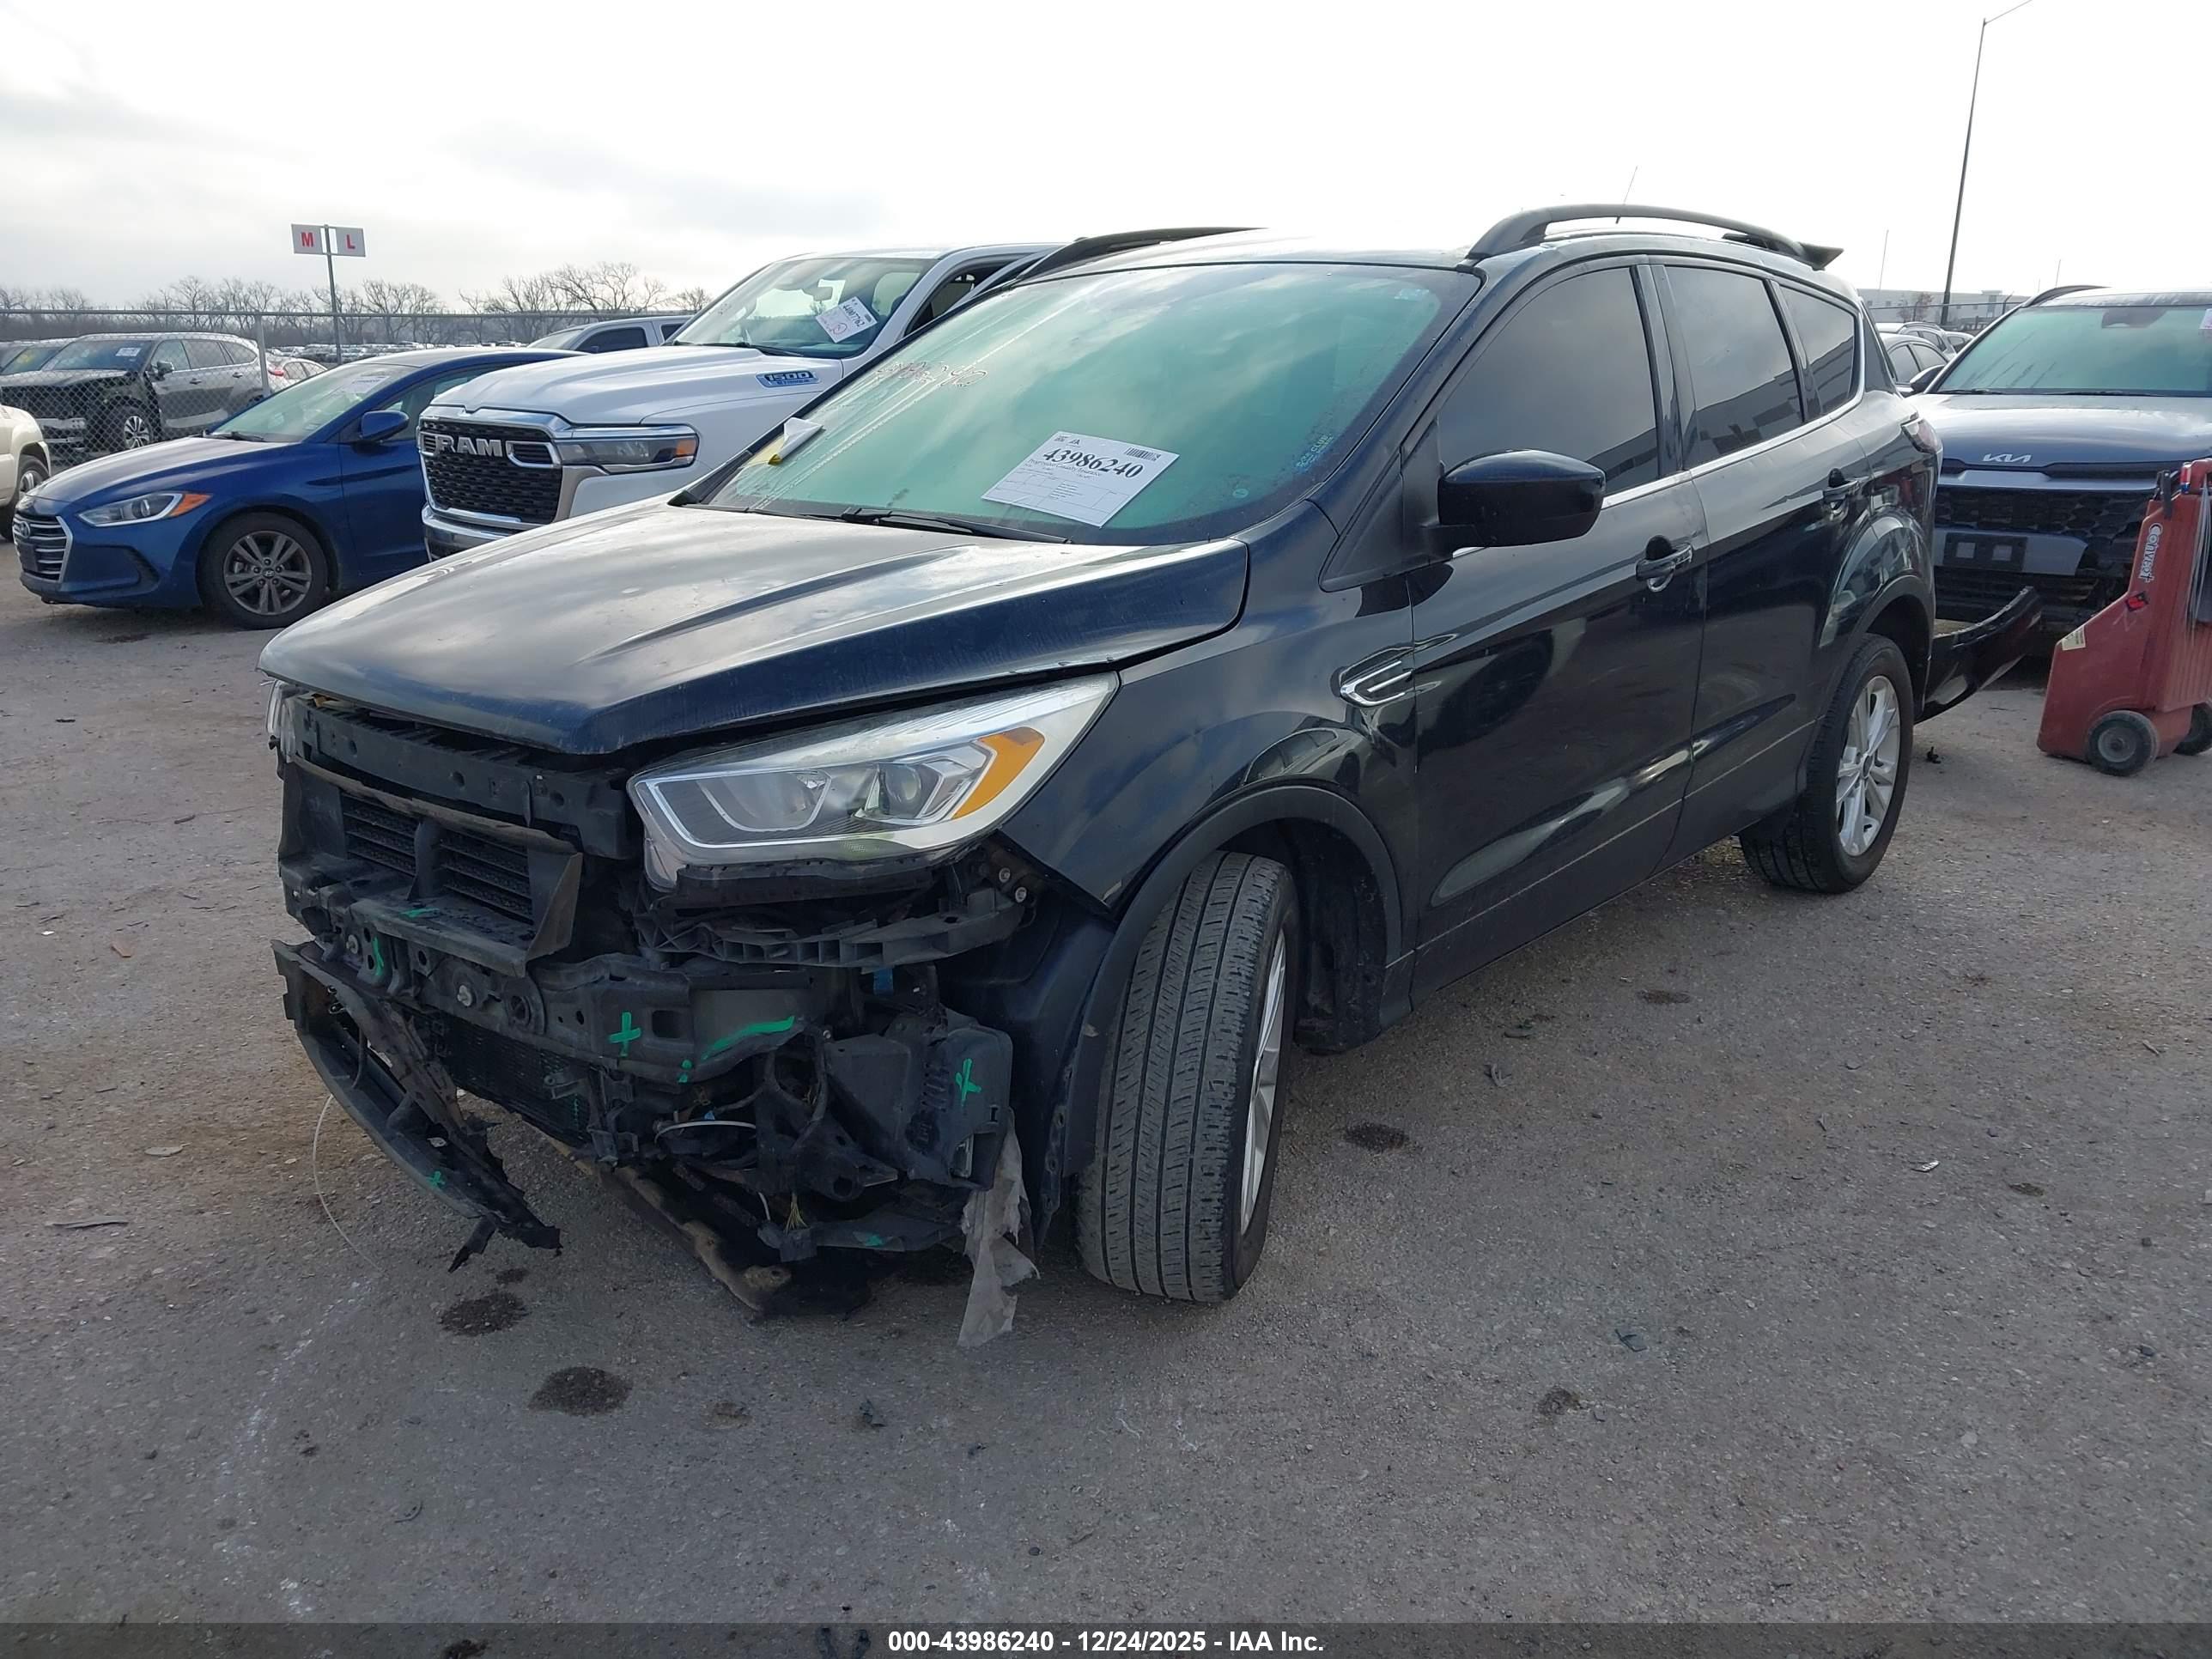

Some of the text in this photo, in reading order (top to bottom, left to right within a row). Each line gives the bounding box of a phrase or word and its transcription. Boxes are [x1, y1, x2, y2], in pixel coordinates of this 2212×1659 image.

[301, 232, 313, 247] M
[346, 234, 356, 249] L
[766, 372, 810, 381] 1500
[436, 434, 503, 457] RAM
[1042, 447, 1144, 478] 43986240
